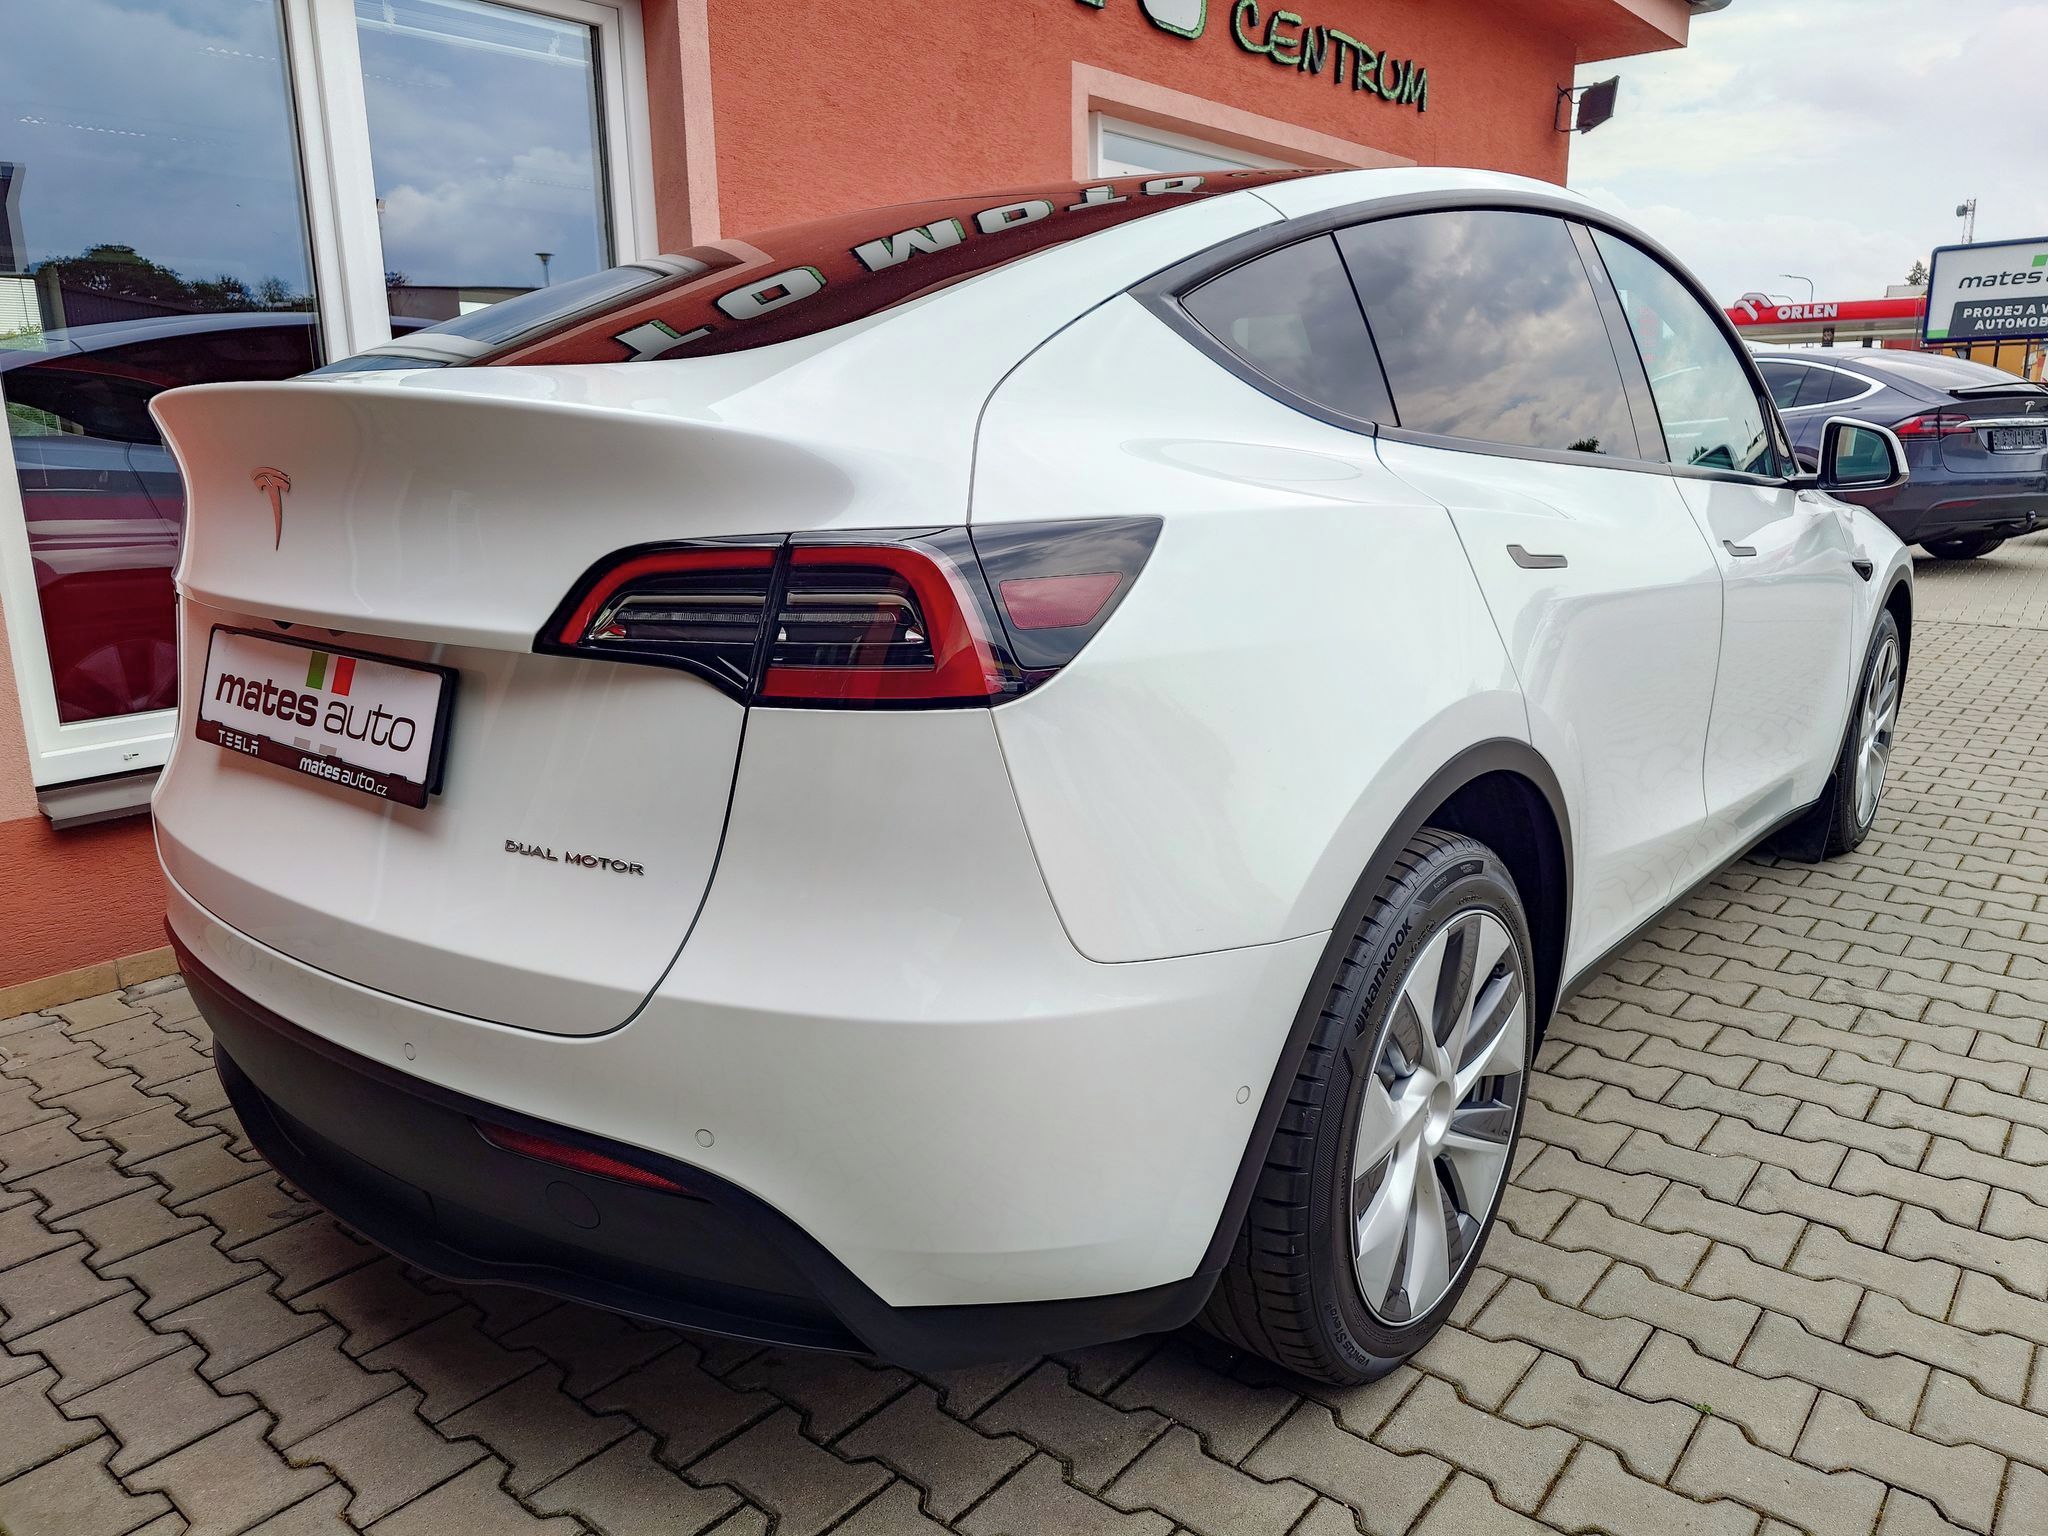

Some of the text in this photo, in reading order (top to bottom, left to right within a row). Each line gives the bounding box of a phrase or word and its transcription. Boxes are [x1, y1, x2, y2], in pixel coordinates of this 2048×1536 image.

[1230, 0, 1428, 112] CENTRUM
[1958, 271, 2043, 289] mates
[1777, 303, 1838, 320] ORLEN
[1963, 305, 2023, 318] PRODEJ
[2026, 304, 2037, 315] A
[216, 673, 416, 752] mates auto
[218, 729, 259, 755] TESLA
[505, 839, 645, 876] DUAL MOTOR
